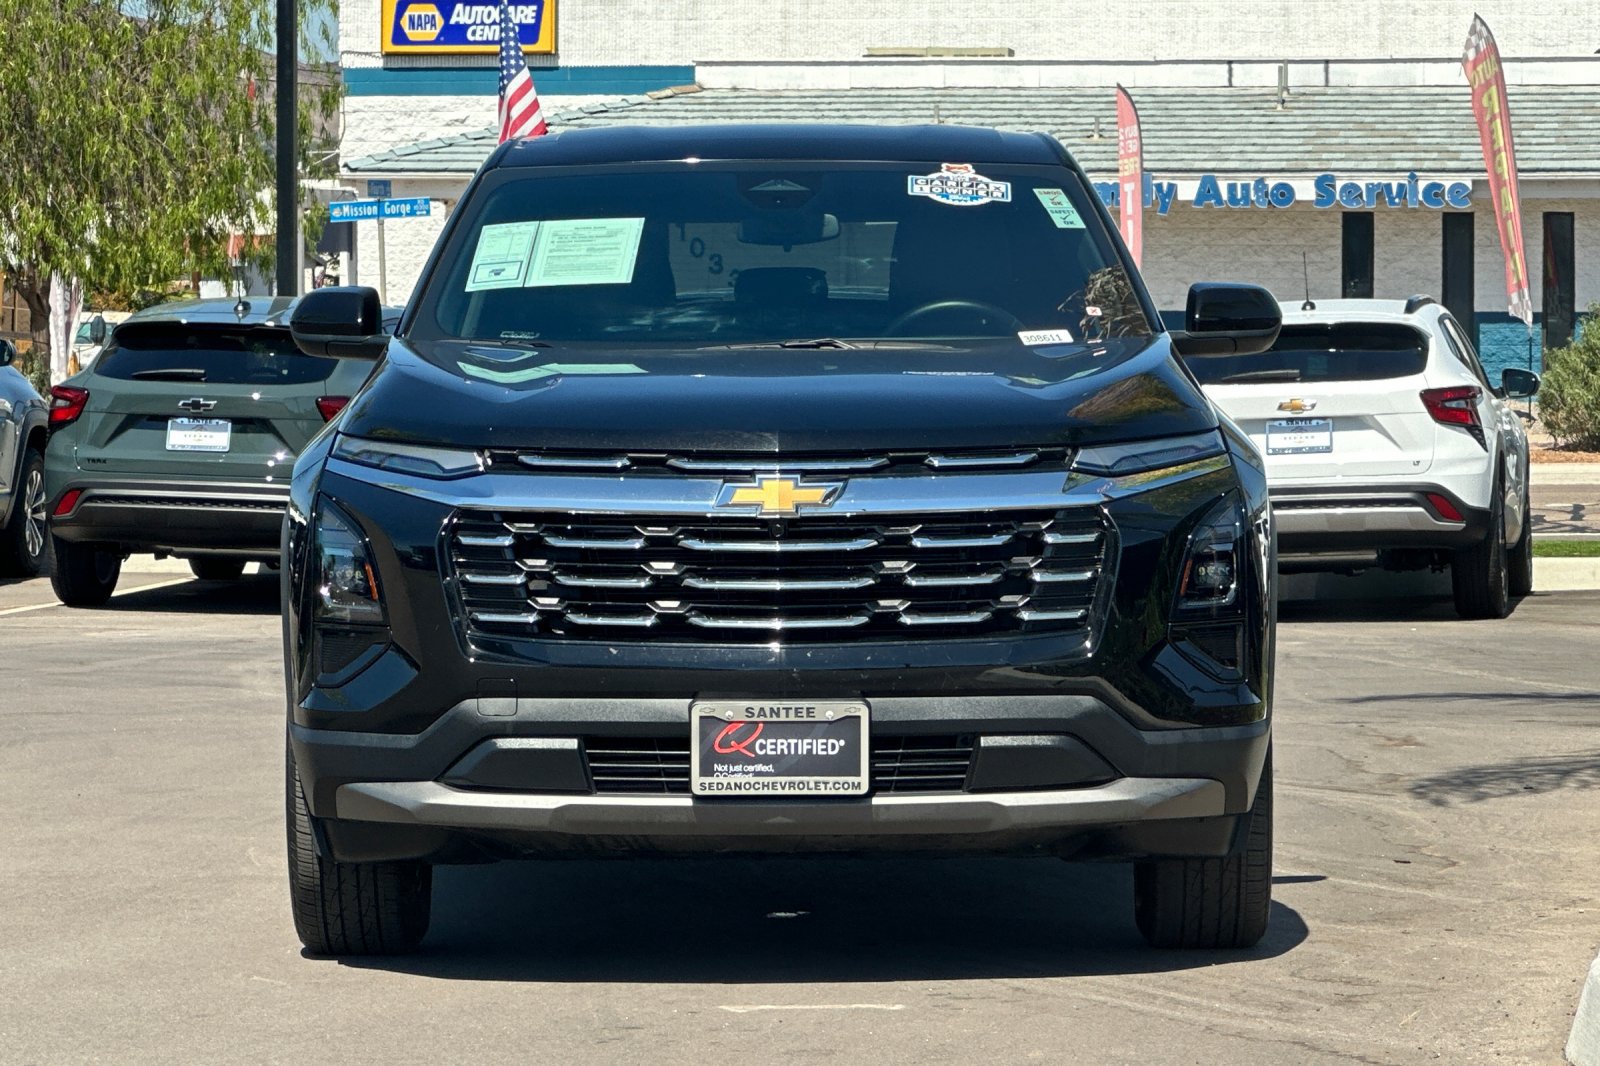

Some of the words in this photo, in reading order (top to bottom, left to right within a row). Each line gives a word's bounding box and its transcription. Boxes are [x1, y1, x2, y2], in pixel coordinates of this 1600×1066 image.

[408, 14, 437, 31] NAPA
[915, 178, 1002, 192] CARFAX
[1192, 174, 1297, 209] Auto
[1313, 171, 1473, 209] Service
[342, 205, 378, 217] Mission
[384, 202, 411, 216] Gorge
[745, 706, 816, 719] SANTEE
[713, 763, 728, 772] Not
[728, 763, 744, 774] just
[699, 781, 862, 791] SEDANOCHEVROLET.COM
